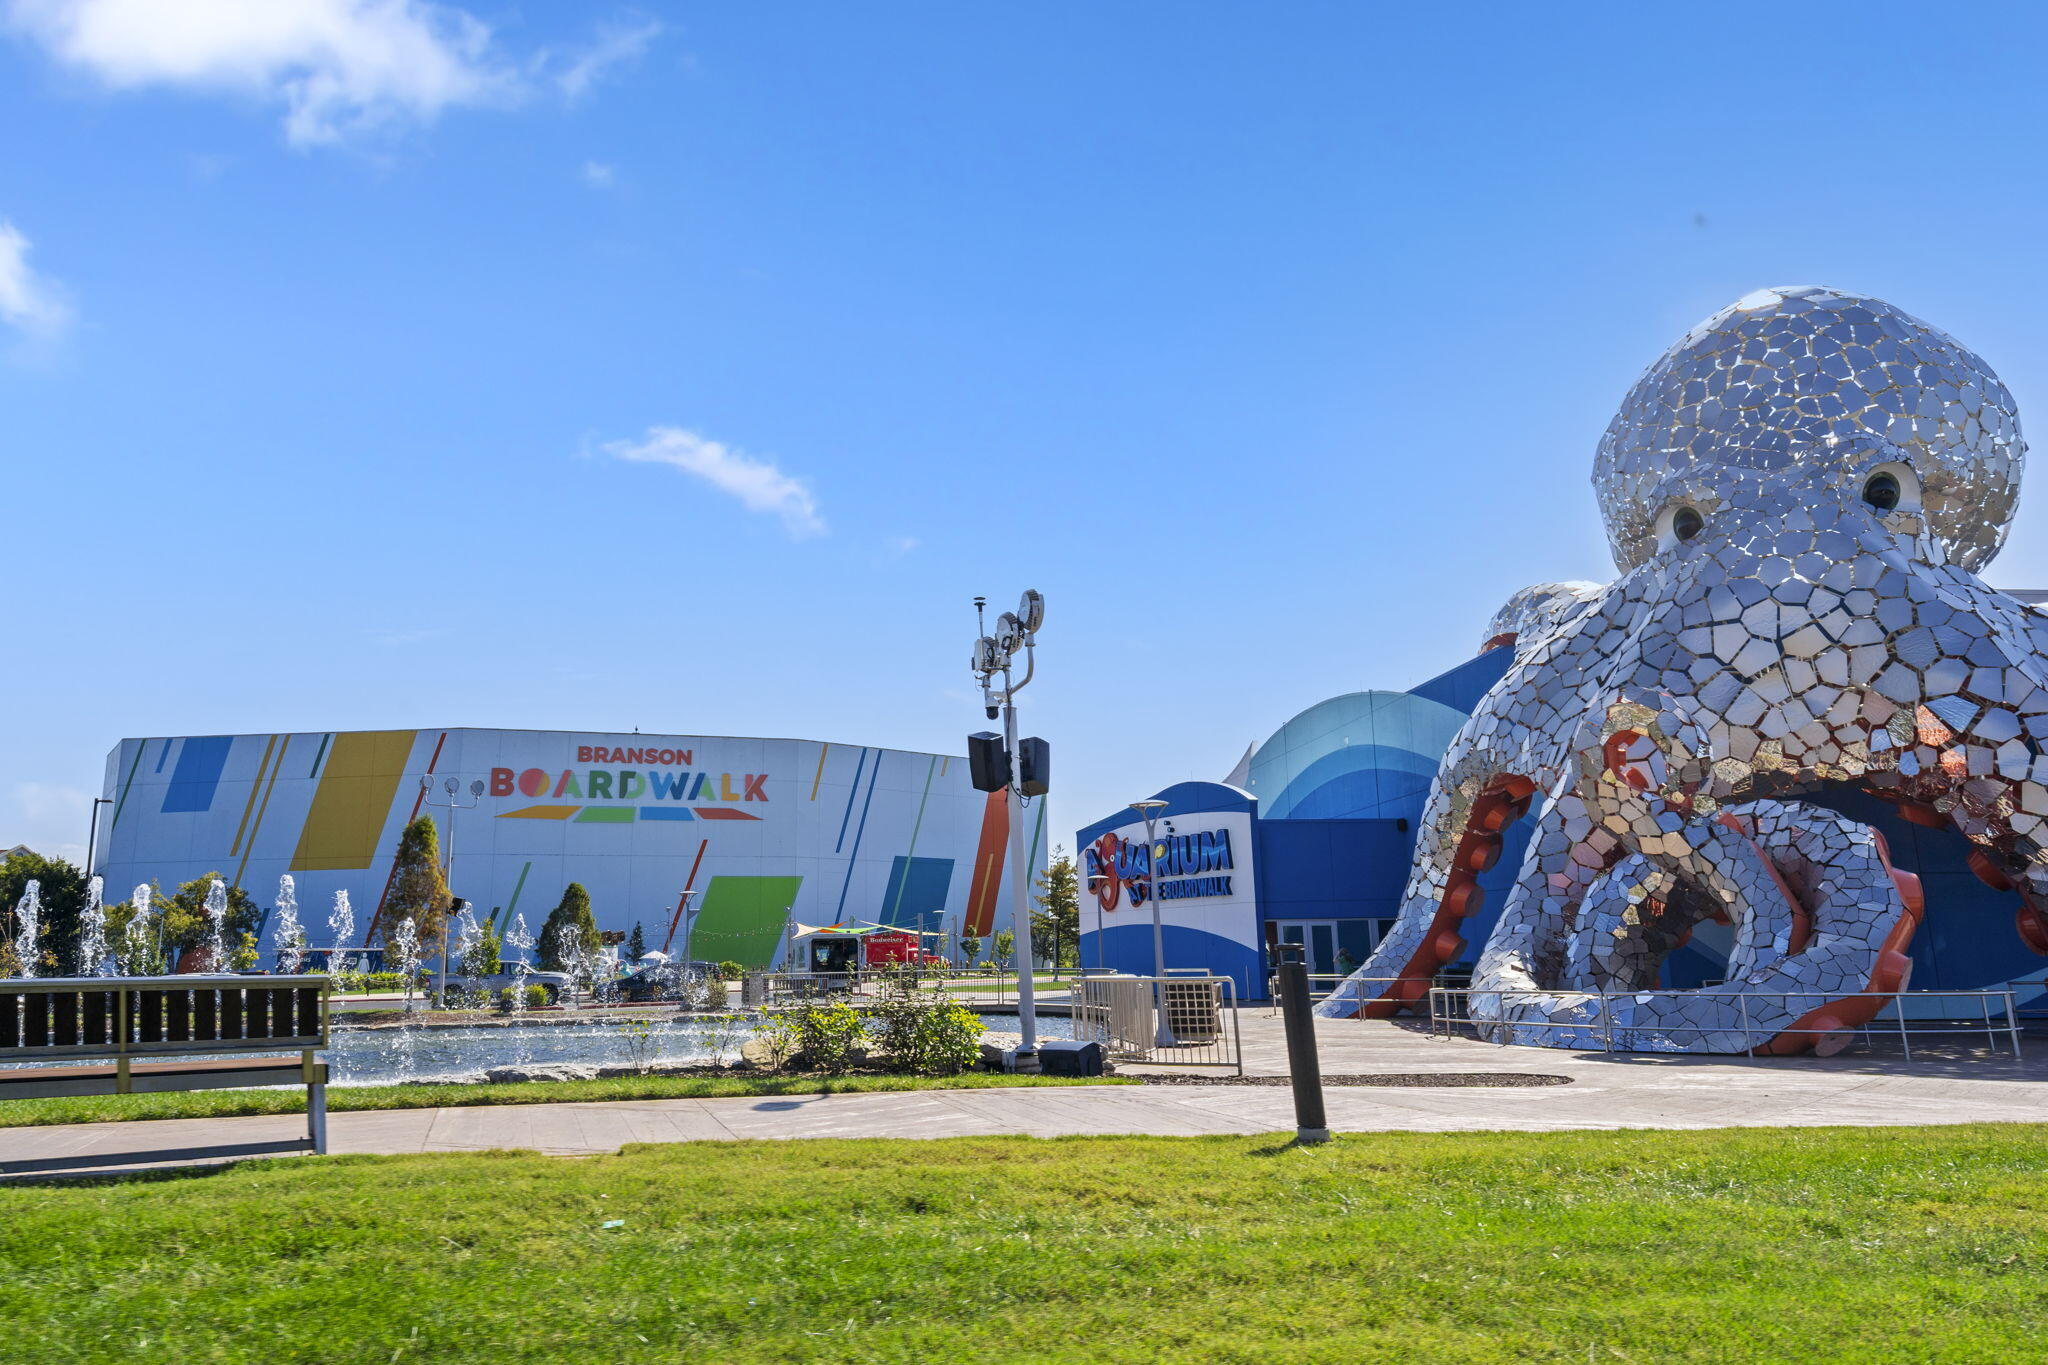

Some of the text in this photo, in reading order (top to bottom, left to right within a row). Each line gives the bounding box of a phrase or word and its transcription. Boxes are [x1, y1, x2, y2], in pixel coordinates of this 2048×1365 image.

[577, 746, 691, 765] BRANSON
[490, 768, 769, 801] BOARDWALK
[1145, 881, 1165, 901] TE
[1165, 876, 1233, 899] BOARDWALK
